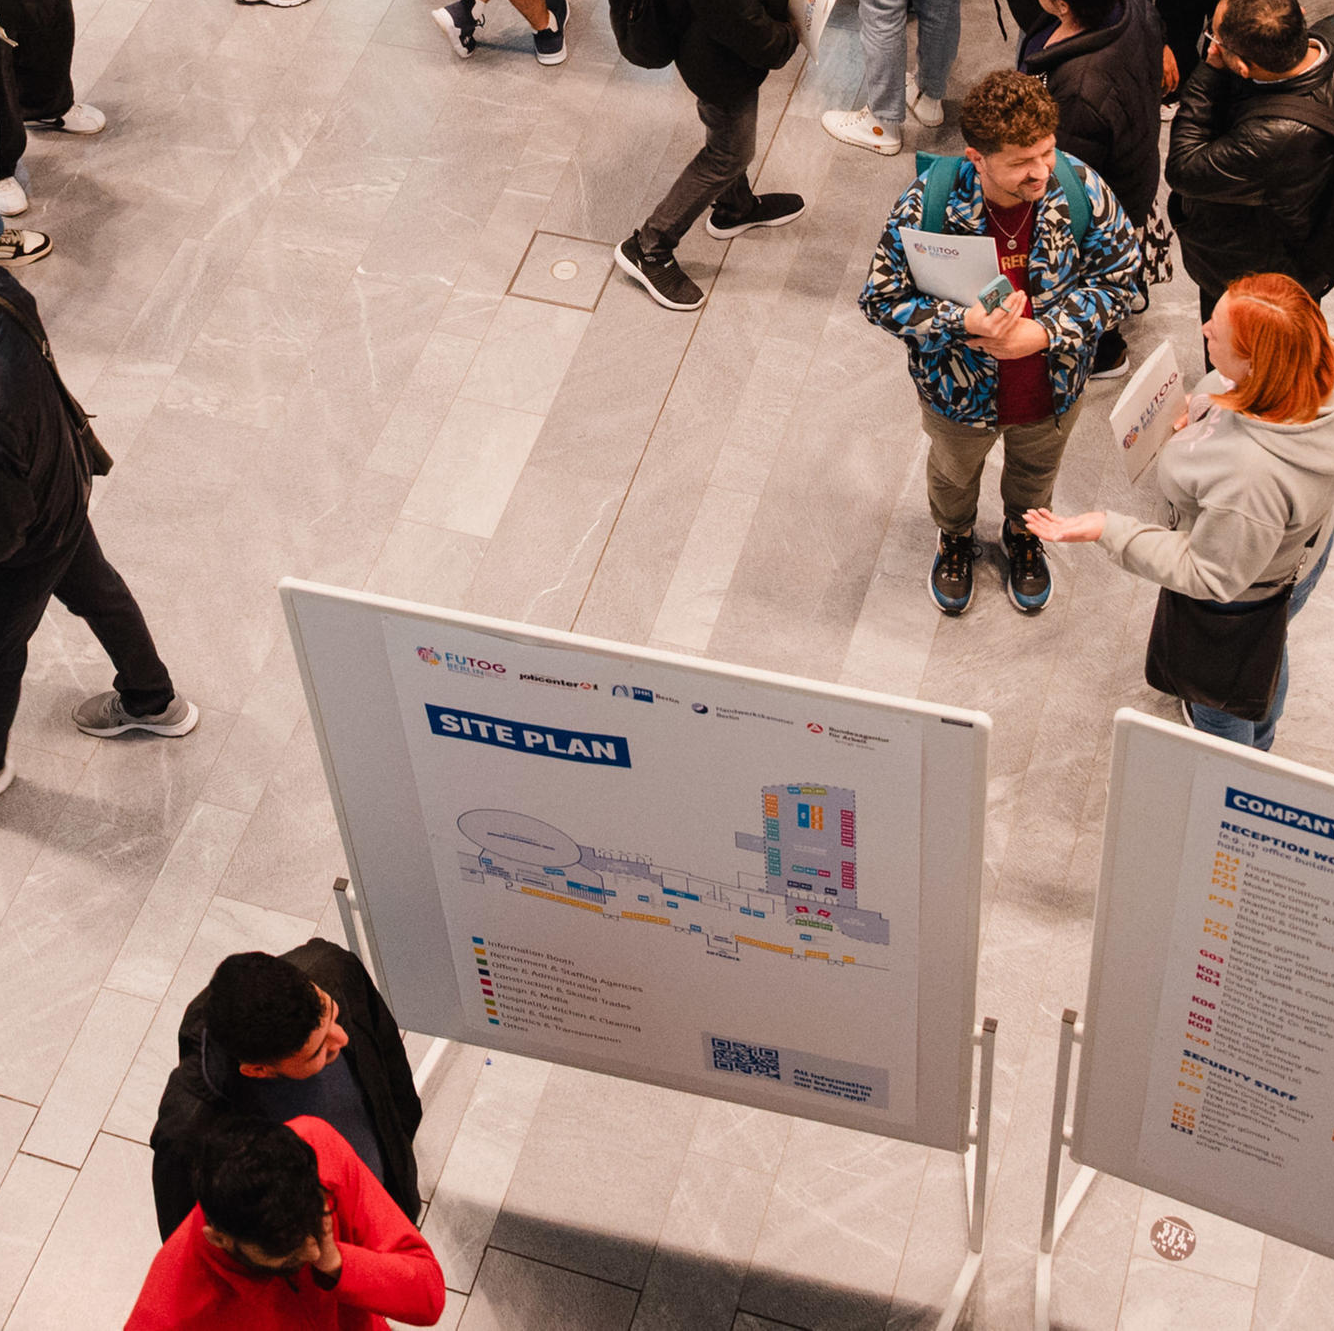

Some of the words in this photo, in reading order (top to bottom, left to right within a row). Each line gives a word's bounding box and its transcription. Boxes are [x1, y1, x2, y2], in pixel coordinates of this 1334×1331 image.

[1001, 254, 1027, 271] REC
[445, 652, 507, 674] FUTOG
[519, 673, 579, 689] jobcenter
[439, 713, 516, 746] SITE
[523, 730, 617, 760] PLAN
[1220, 821, 1310, 856] RECEPTION
[1183, 1049, 1252, 1082] SECURITY
[1254, 1080, 1297, 1101] STAFF
